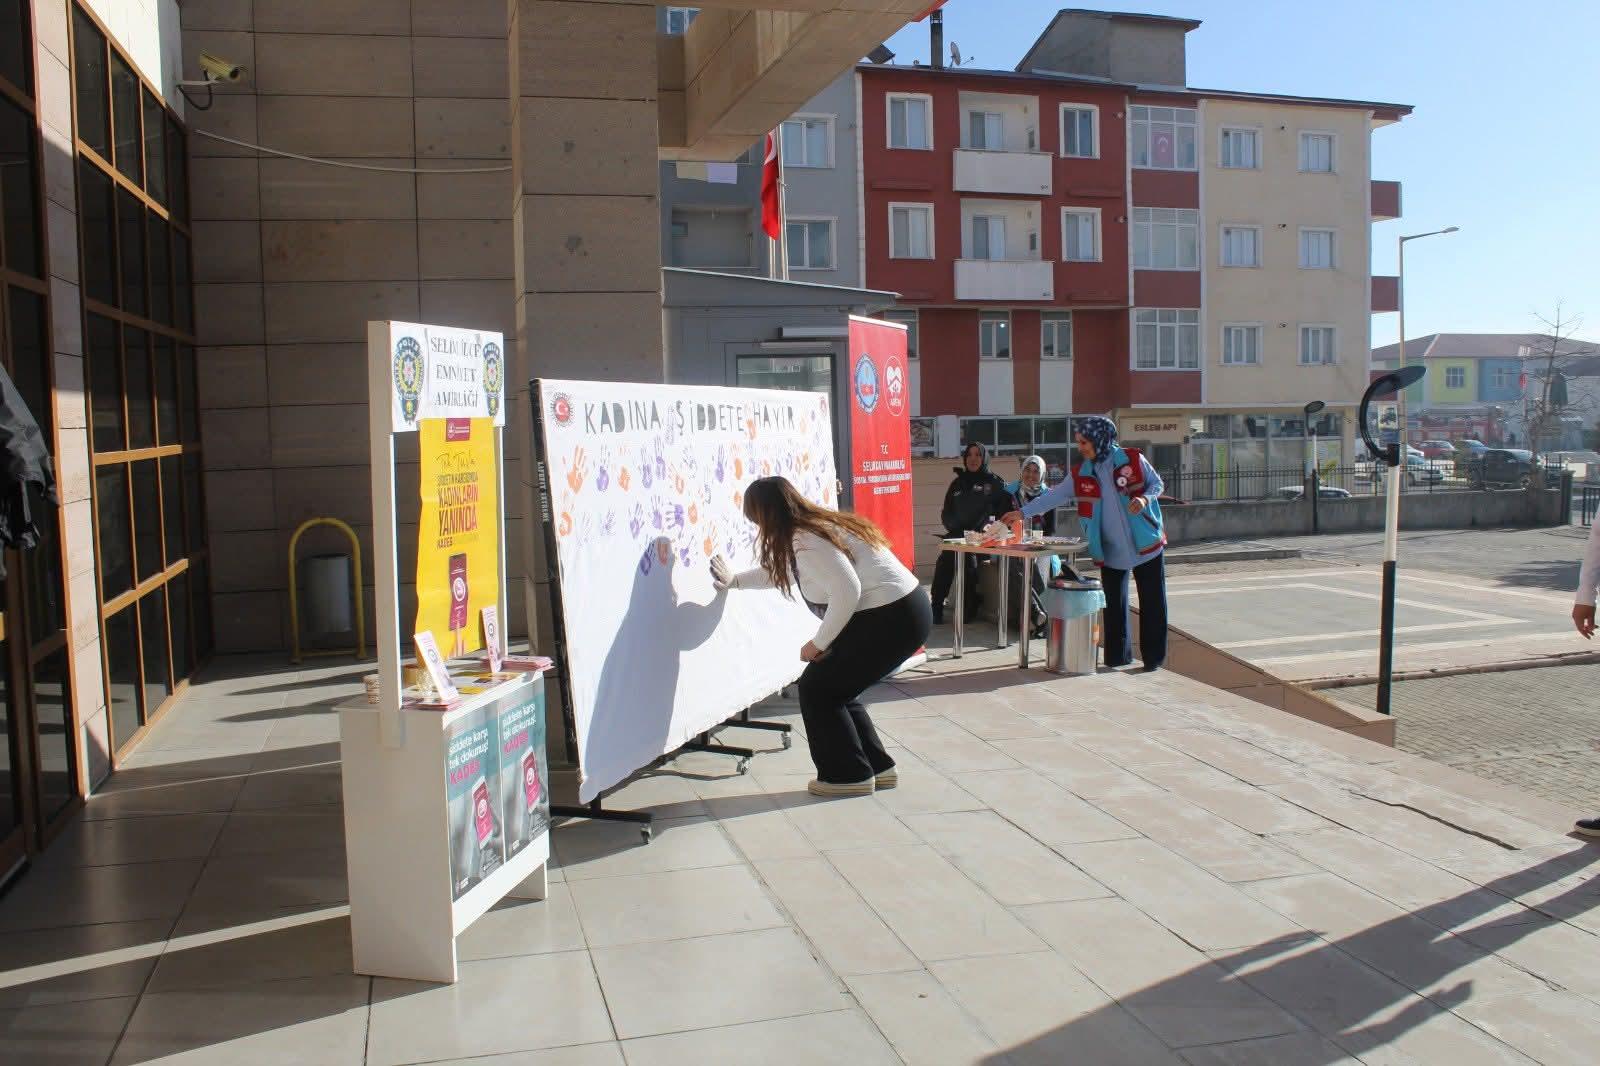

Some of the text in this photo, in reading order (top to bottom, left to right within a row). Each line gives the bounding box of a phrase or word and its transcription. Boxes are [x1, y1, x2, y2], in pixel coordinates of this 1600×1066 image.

[584, 400, 795, 436] KADINA ŞİDDETE HAYIR
[438, 482, 479, 508] KADINLARIN
[439, 504, 478, 537] YANINDA
